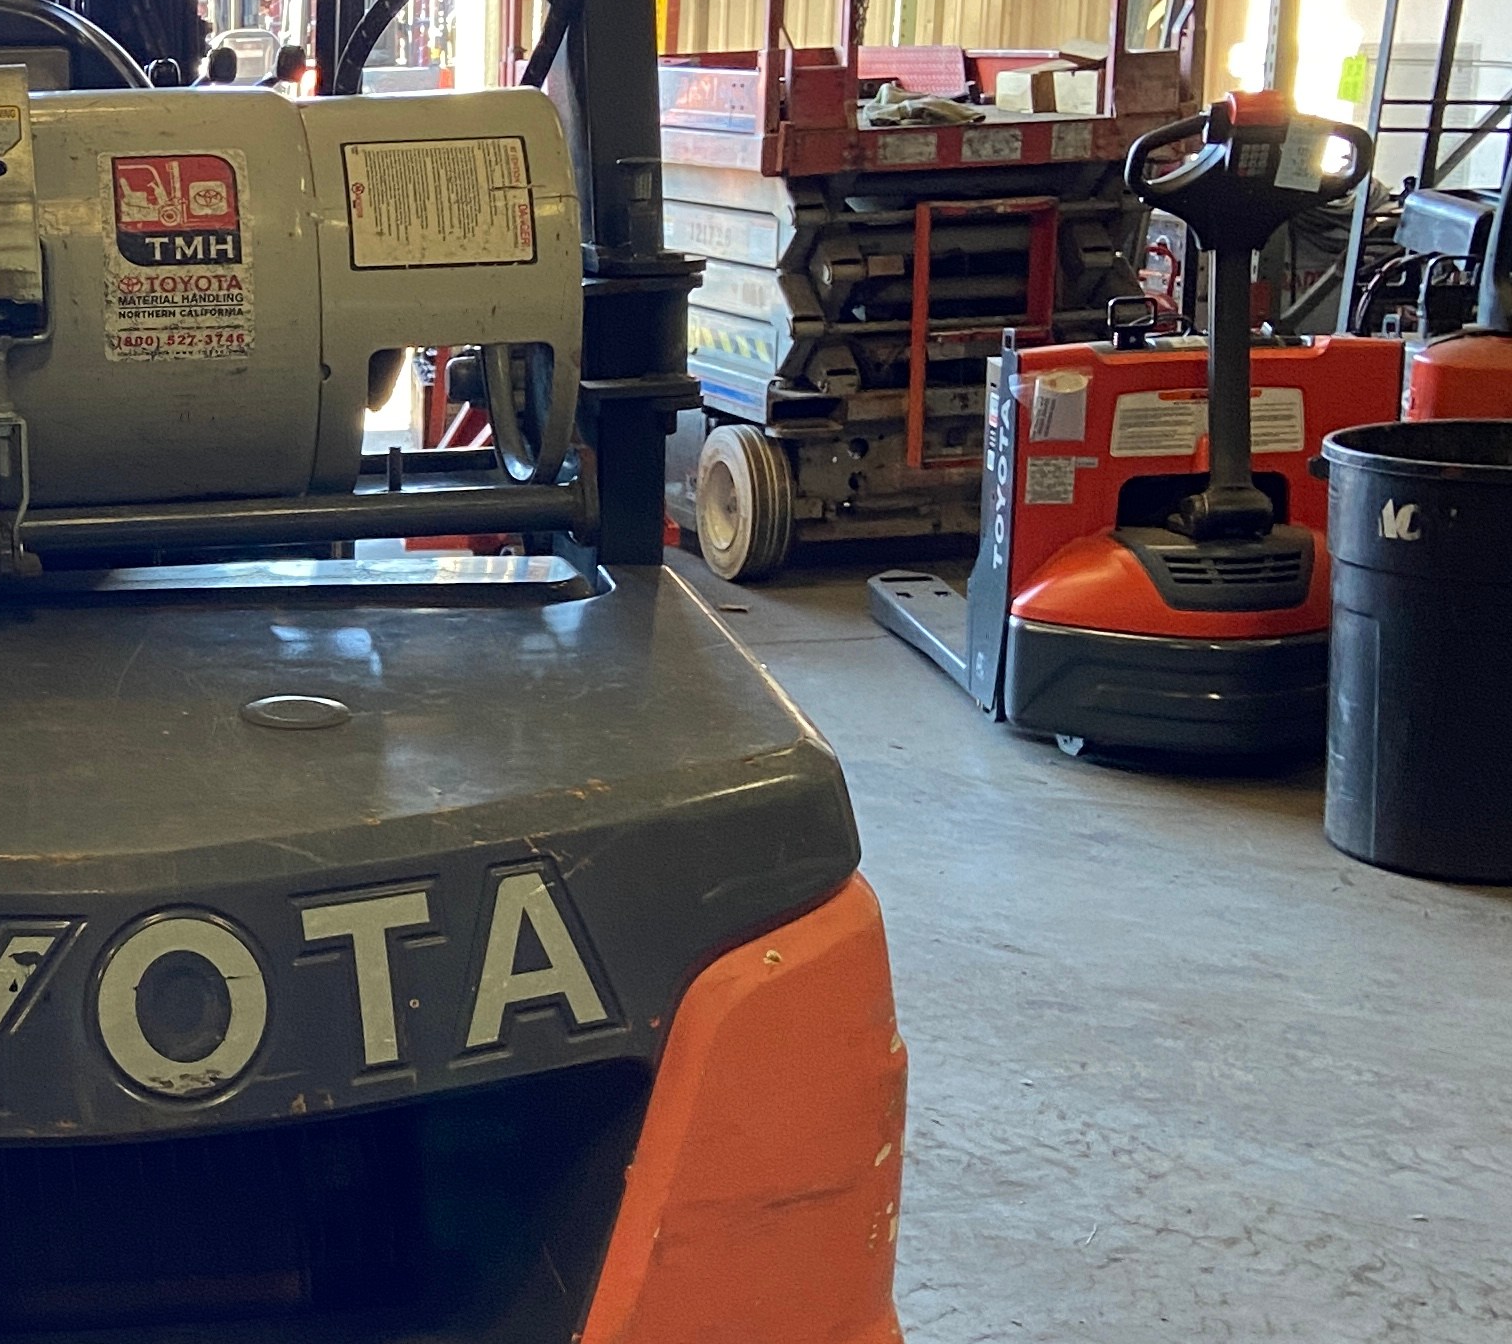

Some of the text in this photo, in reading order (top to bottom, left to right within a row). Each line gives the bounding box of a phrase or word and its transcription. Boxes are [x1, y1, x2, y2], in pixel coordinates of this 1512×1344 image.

[145, 235, 234, 260] TMH
[145, 274, 243, 293] TOYOTA
[118, 292, 244, 306] MATERIAL HANDLING
[118, 307, 244, 319] NORTHERN CALIFORNIA
[992, 398, 1011, 570] TOYOTA
